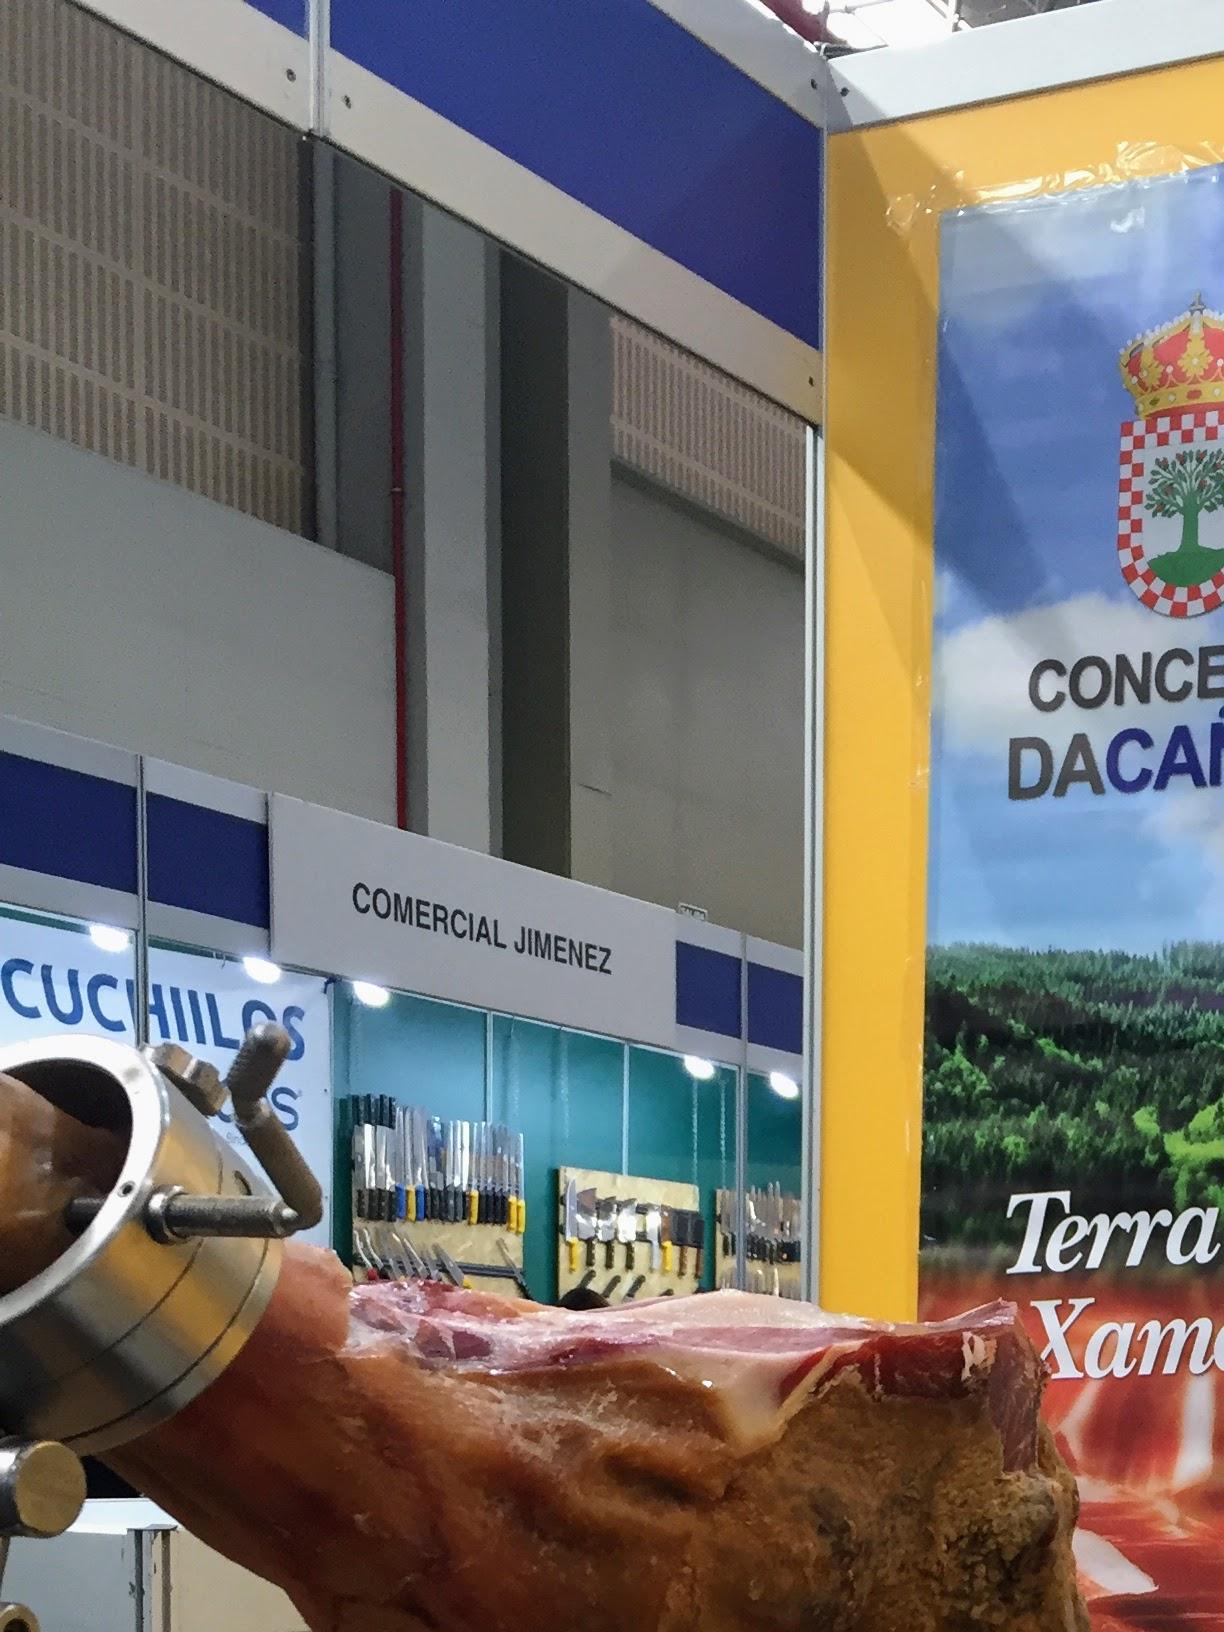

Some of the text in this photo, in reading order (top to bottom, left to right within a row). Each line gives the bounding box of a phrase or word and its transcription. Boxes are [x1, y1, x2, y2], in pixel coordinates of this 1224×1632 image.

[352, 882, 613, 975] COMERCIAL JIMENEZ
[1006, 1190, 1221, 1275] Terra
